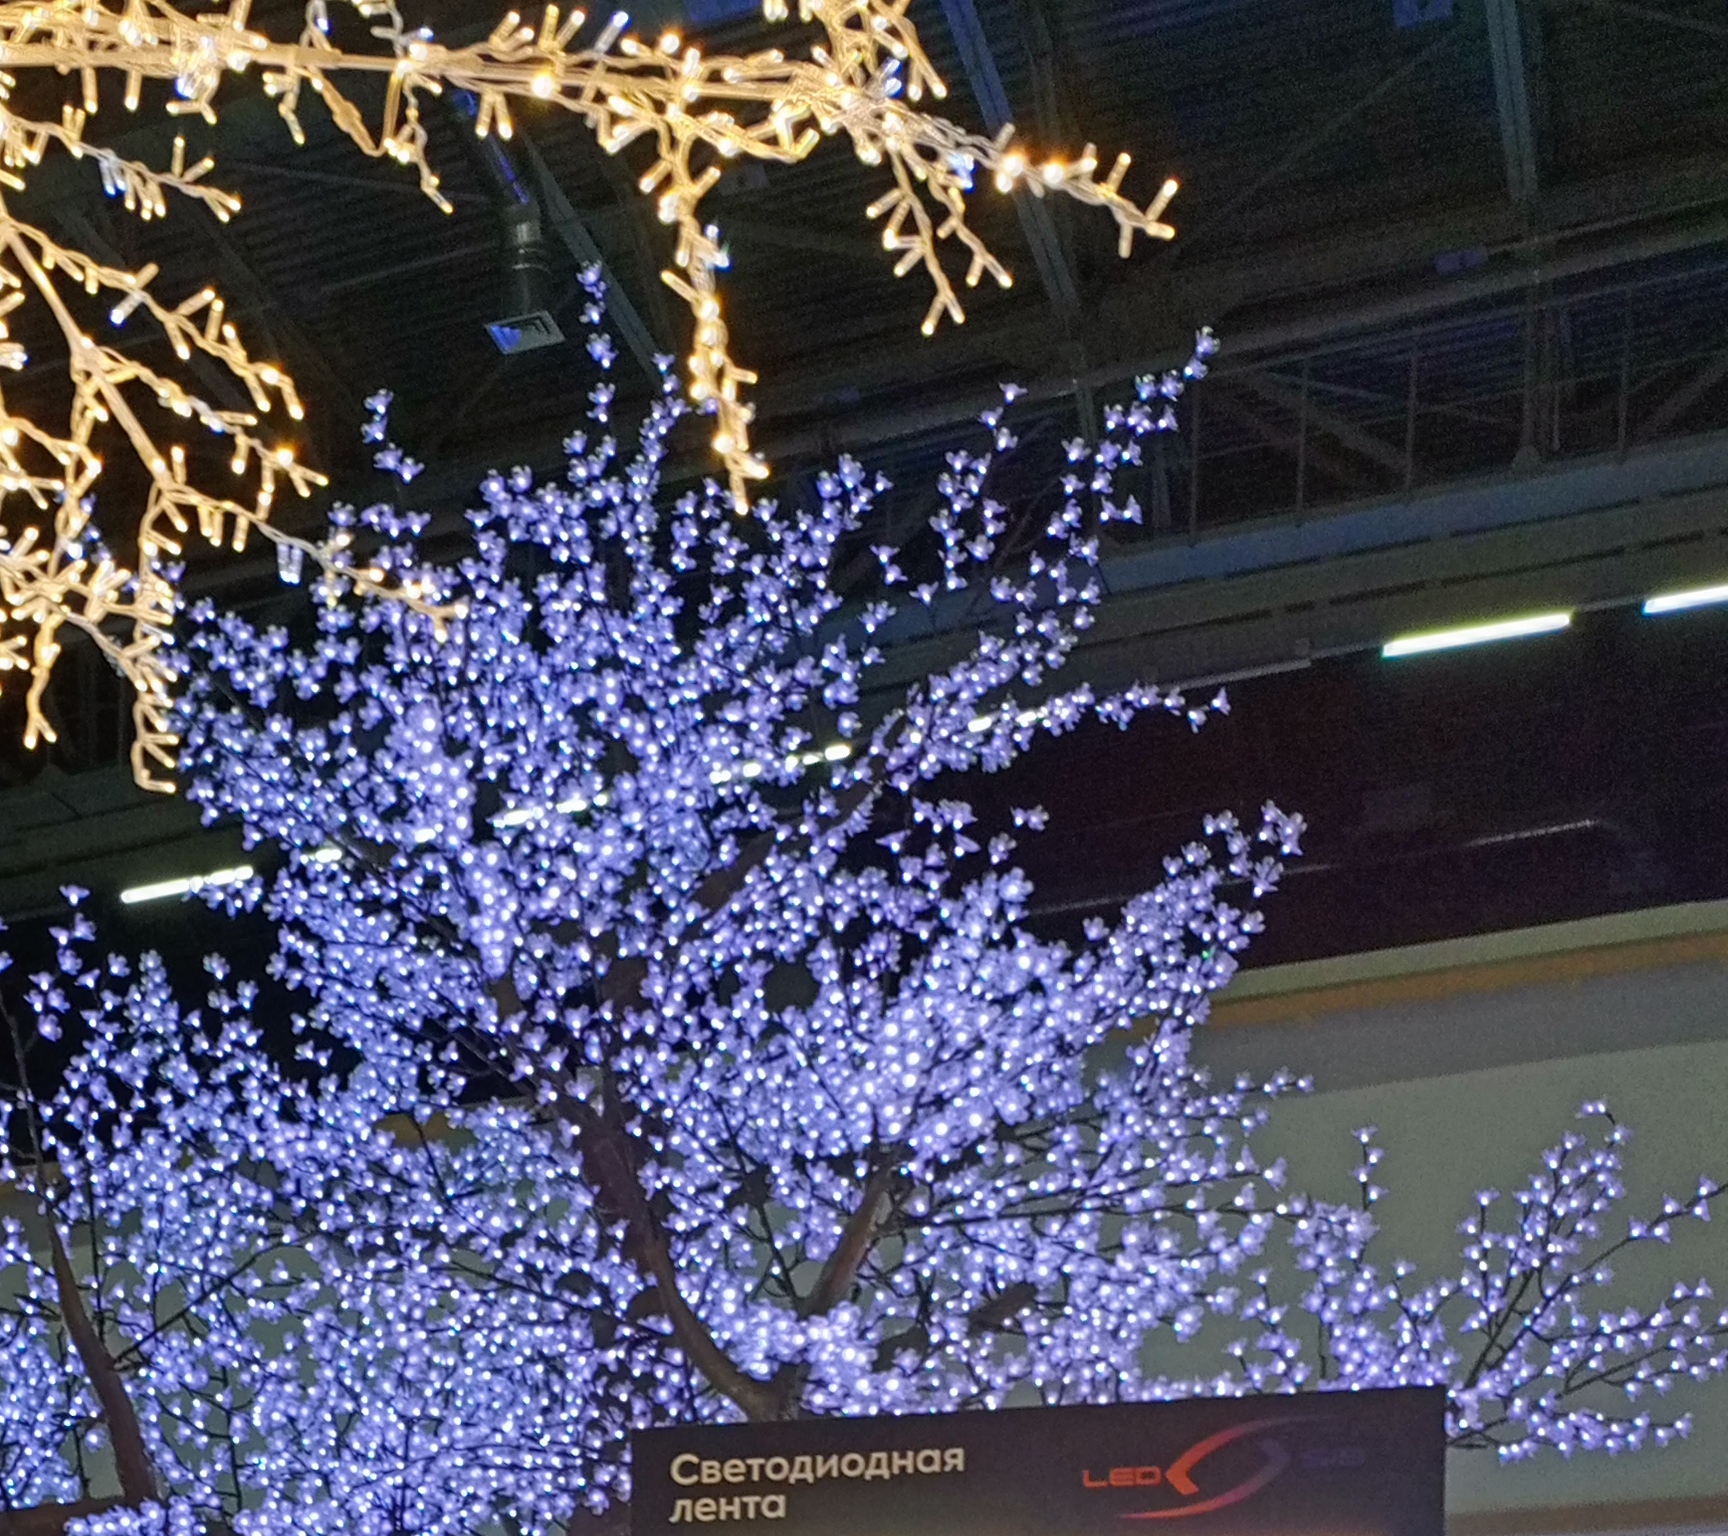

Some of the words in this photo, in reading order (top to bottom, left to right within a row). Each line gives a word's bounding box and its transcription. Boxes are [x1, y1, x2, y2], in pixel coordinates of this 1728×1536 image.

[670, 1446, 966, 1486] Светодиодная
[1082, 1465, 1162, 1489] LED
[670, 1493, 787, 1523] лента
